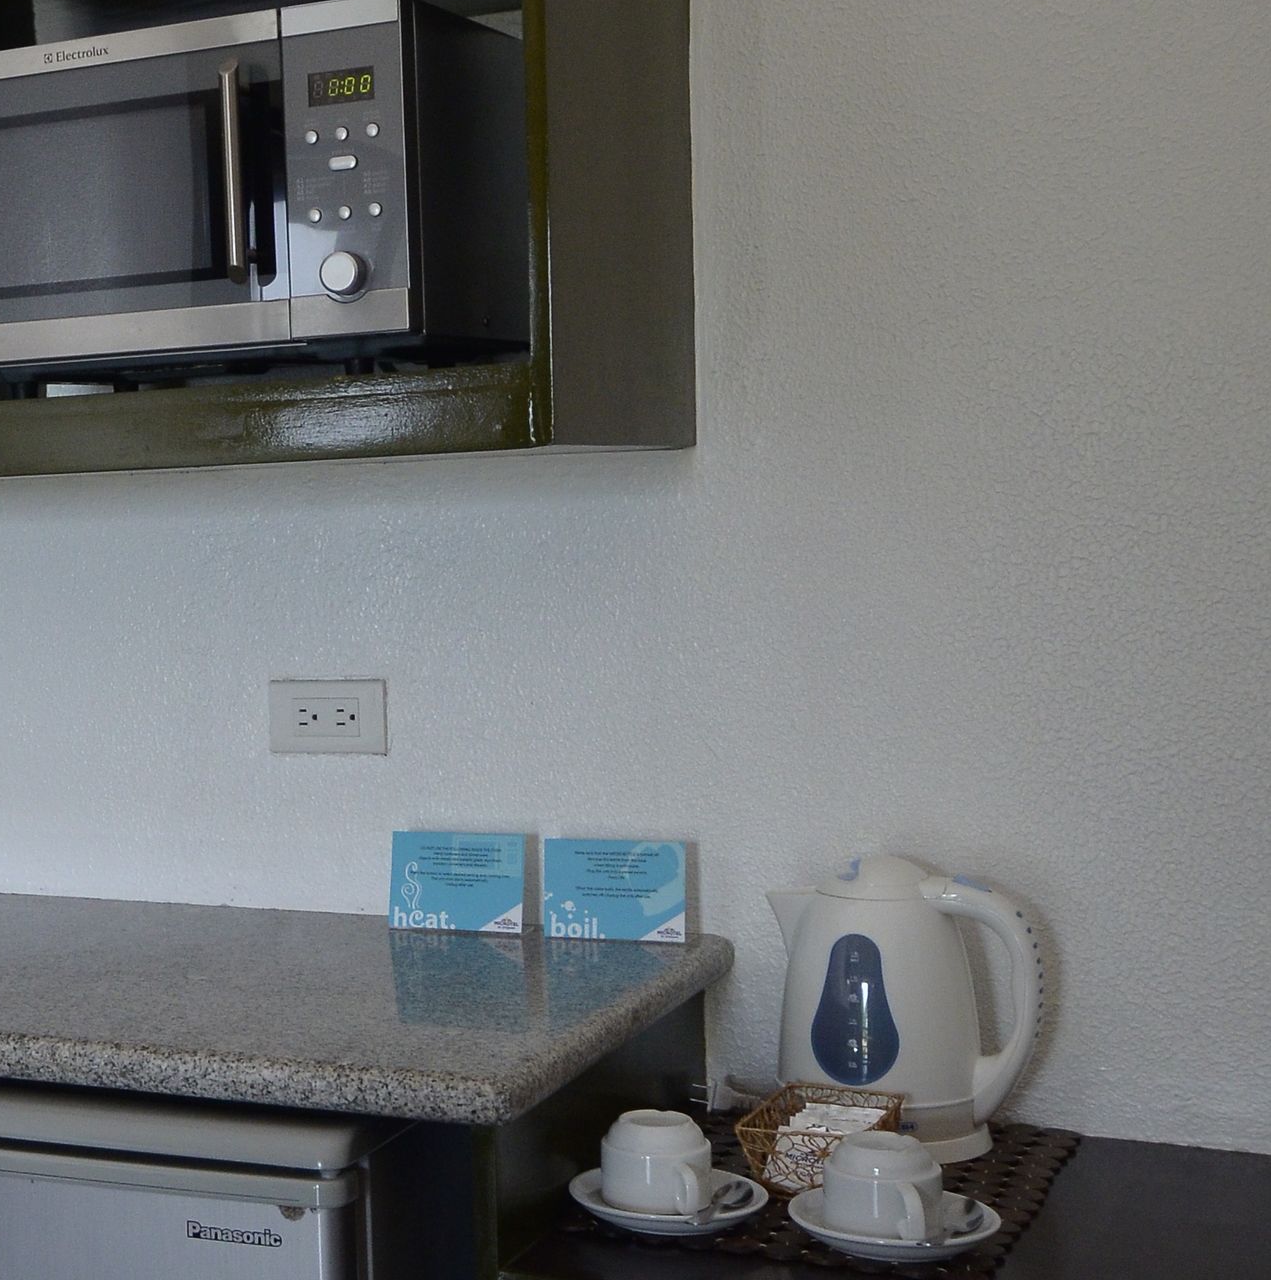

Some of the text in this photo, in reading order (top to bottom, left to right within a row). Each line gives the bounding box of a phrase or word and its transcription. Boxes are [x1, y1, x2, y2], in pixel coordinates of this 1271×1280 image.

[56, 46, 109, 62] Electrolux
[328, 74, 371, 97] 0:00
[393, 906, 456, 930] heat.
[550, 912, 606, 939] boil.
[186, 1220, 283, 1248] Panasonic
